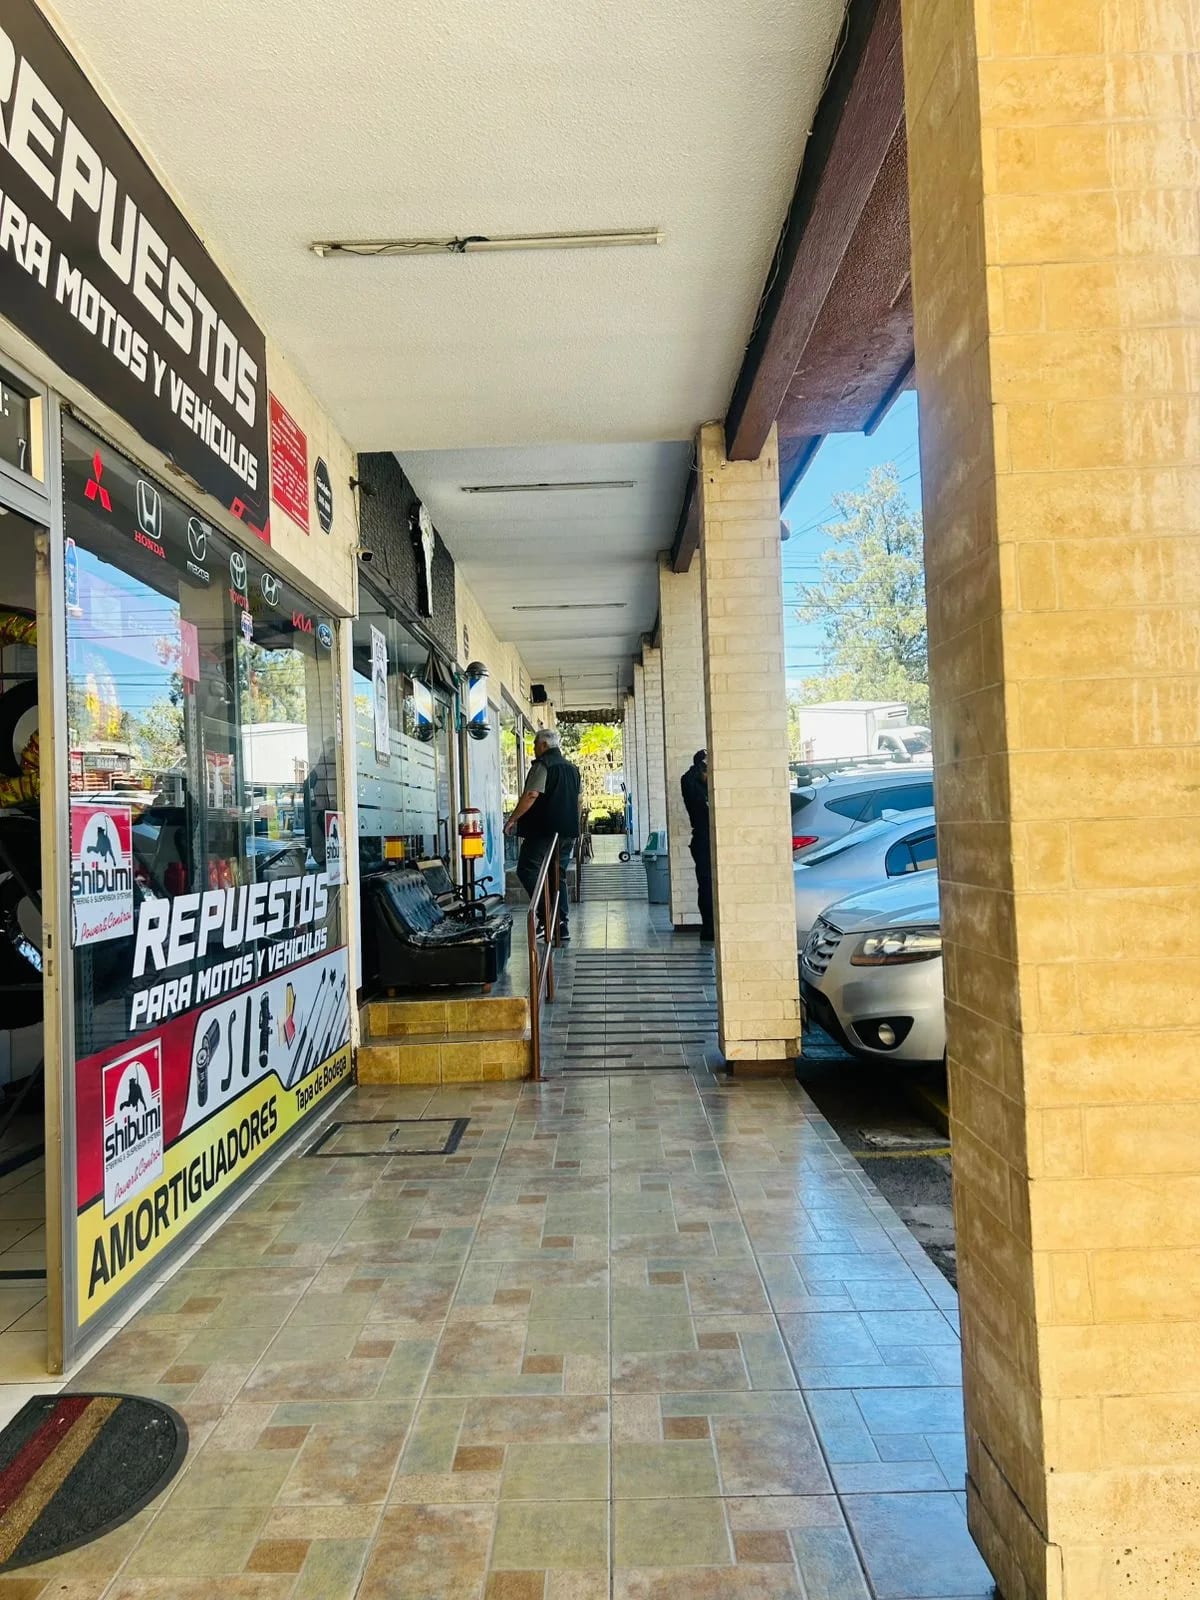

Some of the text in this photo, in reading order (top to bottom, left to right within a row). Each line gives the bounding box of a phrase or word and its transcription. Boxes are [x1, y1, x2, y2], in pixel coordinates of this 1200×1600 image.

[56, 253, 148, 382] MOTOS
[153, 350, 168, 398] Y
[170, 368, 258, 491] VEHÍCULOS
[134, 530, 166, 559] HONDA
[229, 589, 249, 609] TOYOTA
[72, 860, 132, 896] shibumi
[132, 872, 329, 978] REPUESTOS
[129, 974, 193, 1031] PARA
[195, 952, 253, 1003] MOTOS
[256, 948, 266, 977] Y
[295, 1055, 346, 1111] Tapa de Bodega
[105, 1099, 161, 1162] shibumi
[88, 1095, 277, 1300] AMORTIGUADORES
